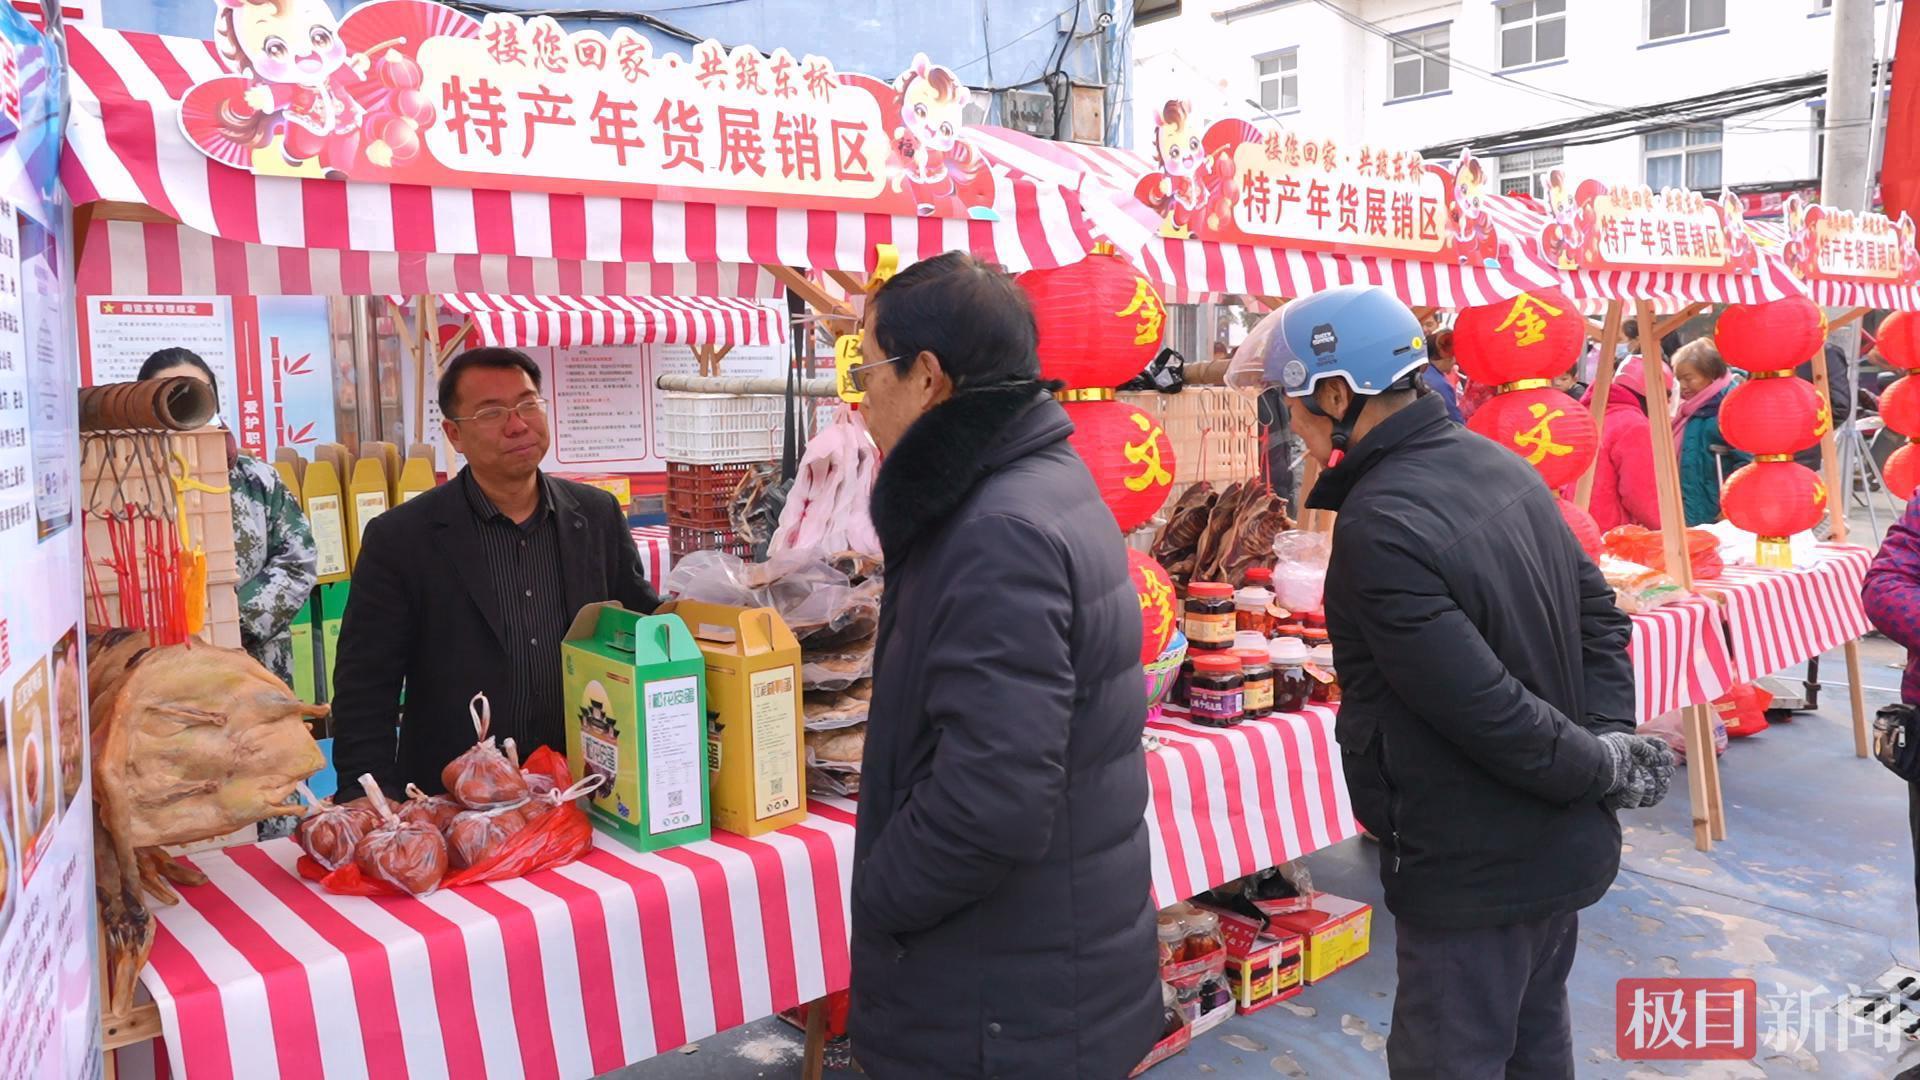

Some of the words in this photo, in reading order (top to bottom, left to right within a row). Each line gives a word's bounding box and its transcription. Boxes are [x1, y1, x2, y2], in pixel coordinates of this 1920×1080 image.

[484, 22, 837, 104] 接您回家·共筑东桥
[441, 75, 875, 182] 特产年货展销区
[1242, 168, 1440, 241] 特产年货展销区
[1601, 214, 1722, 258] 特产年货展销区
[1819, 234, 1897, 271] 特产年货展销区
[1114, 276, 1168, 346] 金
[1494, 292, 1564, 347] 金
[1122, 412, 1173, 492] 文
[1513, 402, 1574, 466] 文
